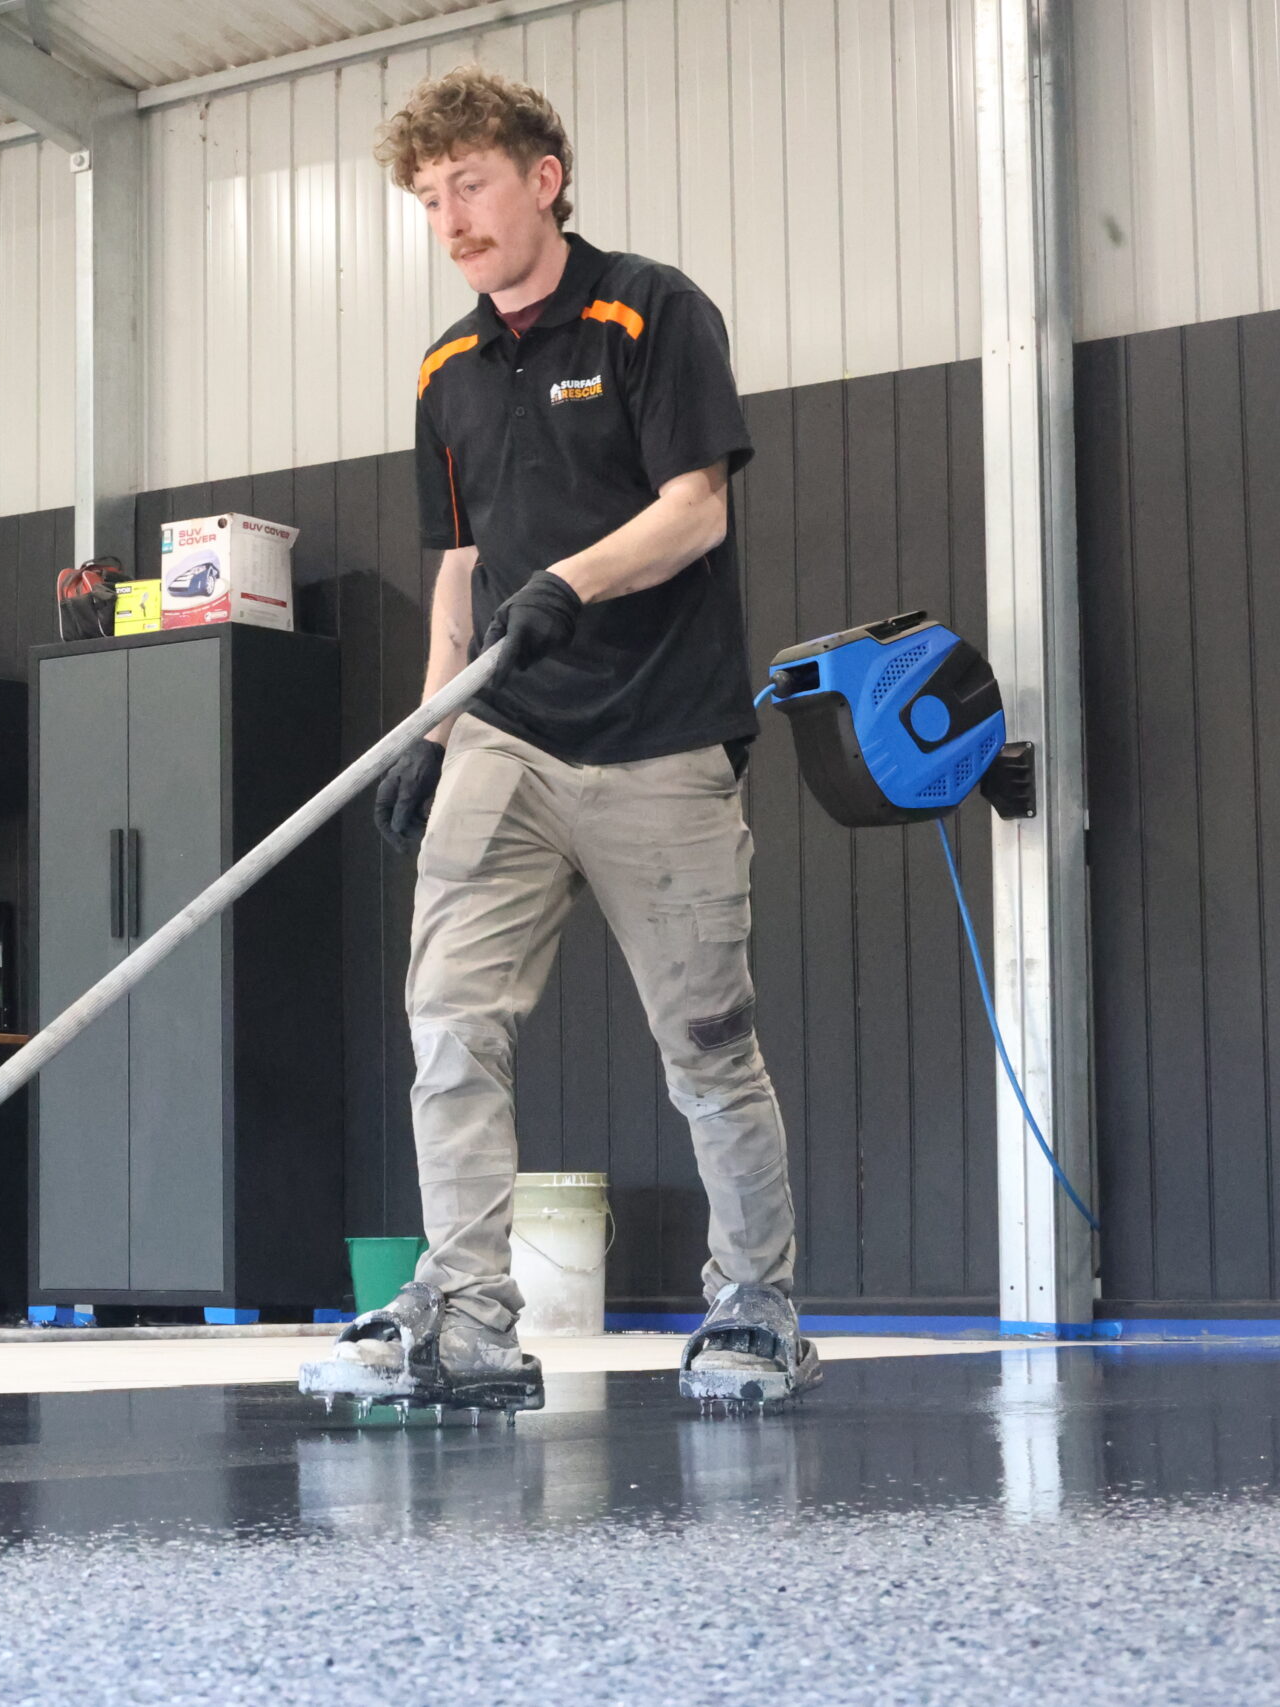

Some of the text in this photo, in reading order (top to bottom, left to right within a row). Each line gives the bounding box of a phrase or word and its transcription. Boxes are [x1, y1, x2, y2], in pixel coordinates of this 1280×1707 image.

[561, 375, 601, 388] SURFACE
[561, 384, 602, 399] RESCUE
[179, 528, 201, 537] SUV
[243, 521, 290, 539] SUV COVER
[179, 534, 216, 546] COVER
